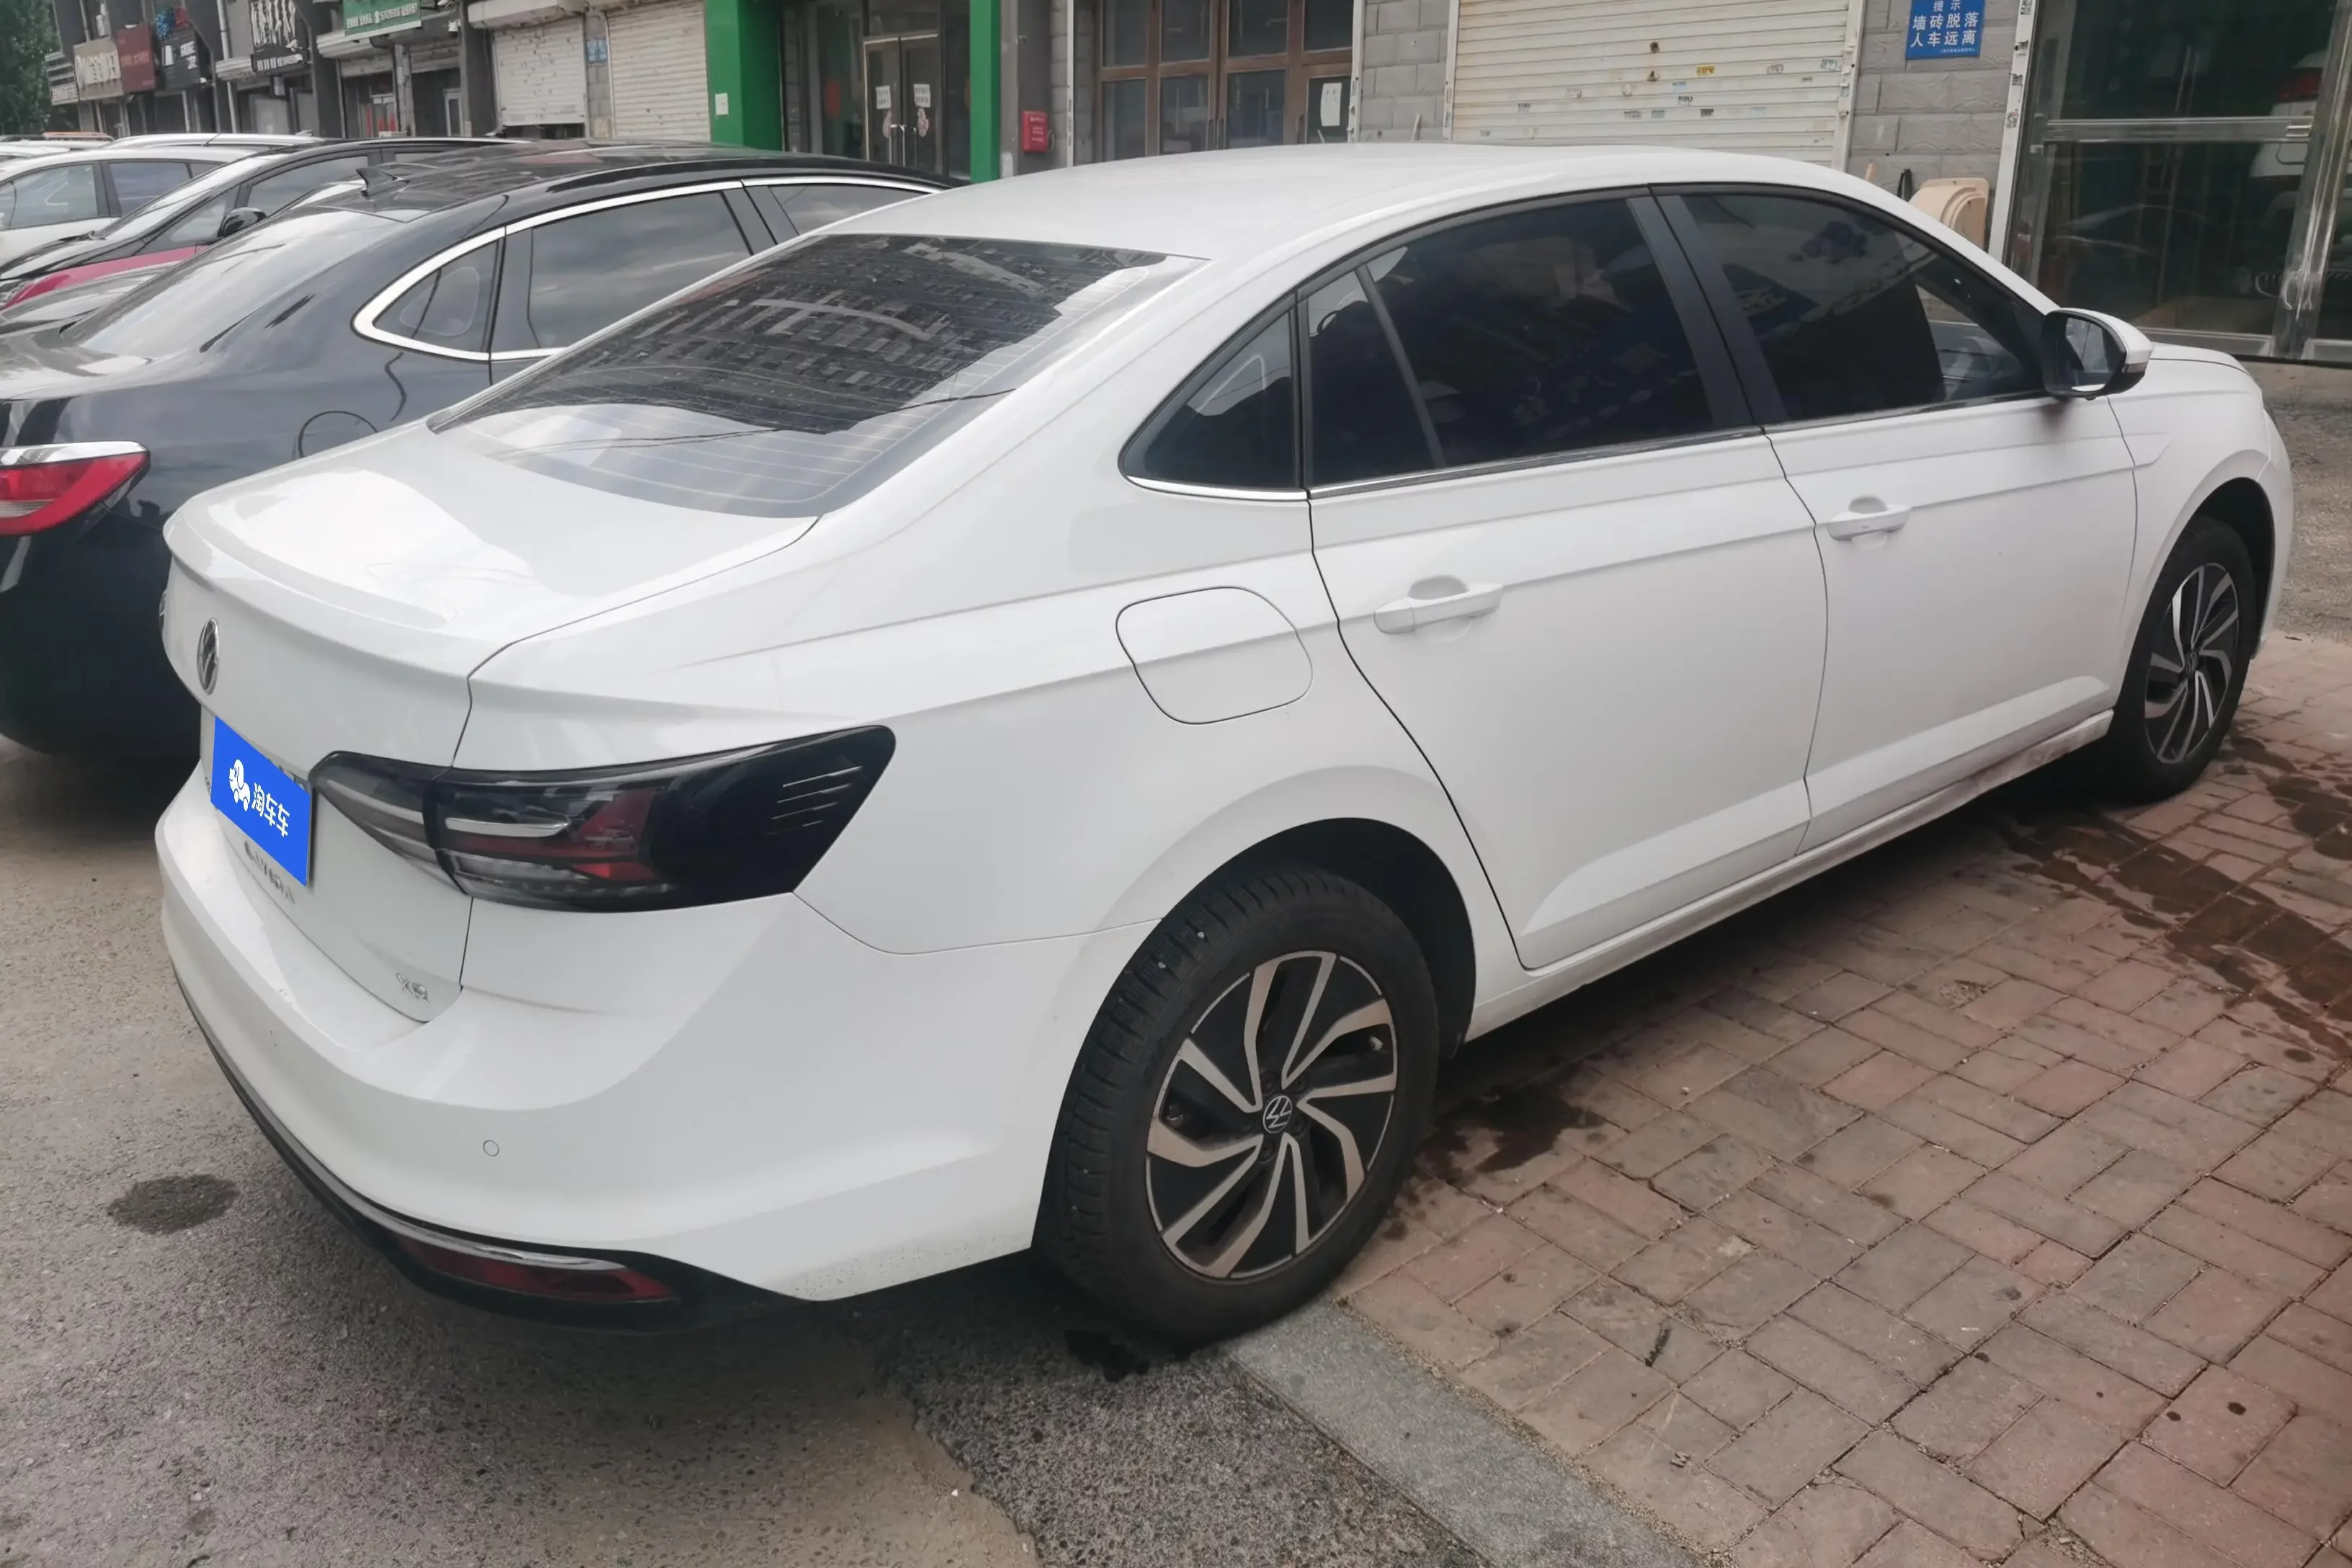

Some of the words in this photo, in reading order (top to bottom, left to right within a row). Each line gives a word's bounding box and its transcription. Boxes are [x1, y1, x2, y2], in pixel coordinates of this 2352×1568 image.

[1912, 12, 1979, 30] 墙砖脱落
[1910, 30, 1977, 48] 人车远离
